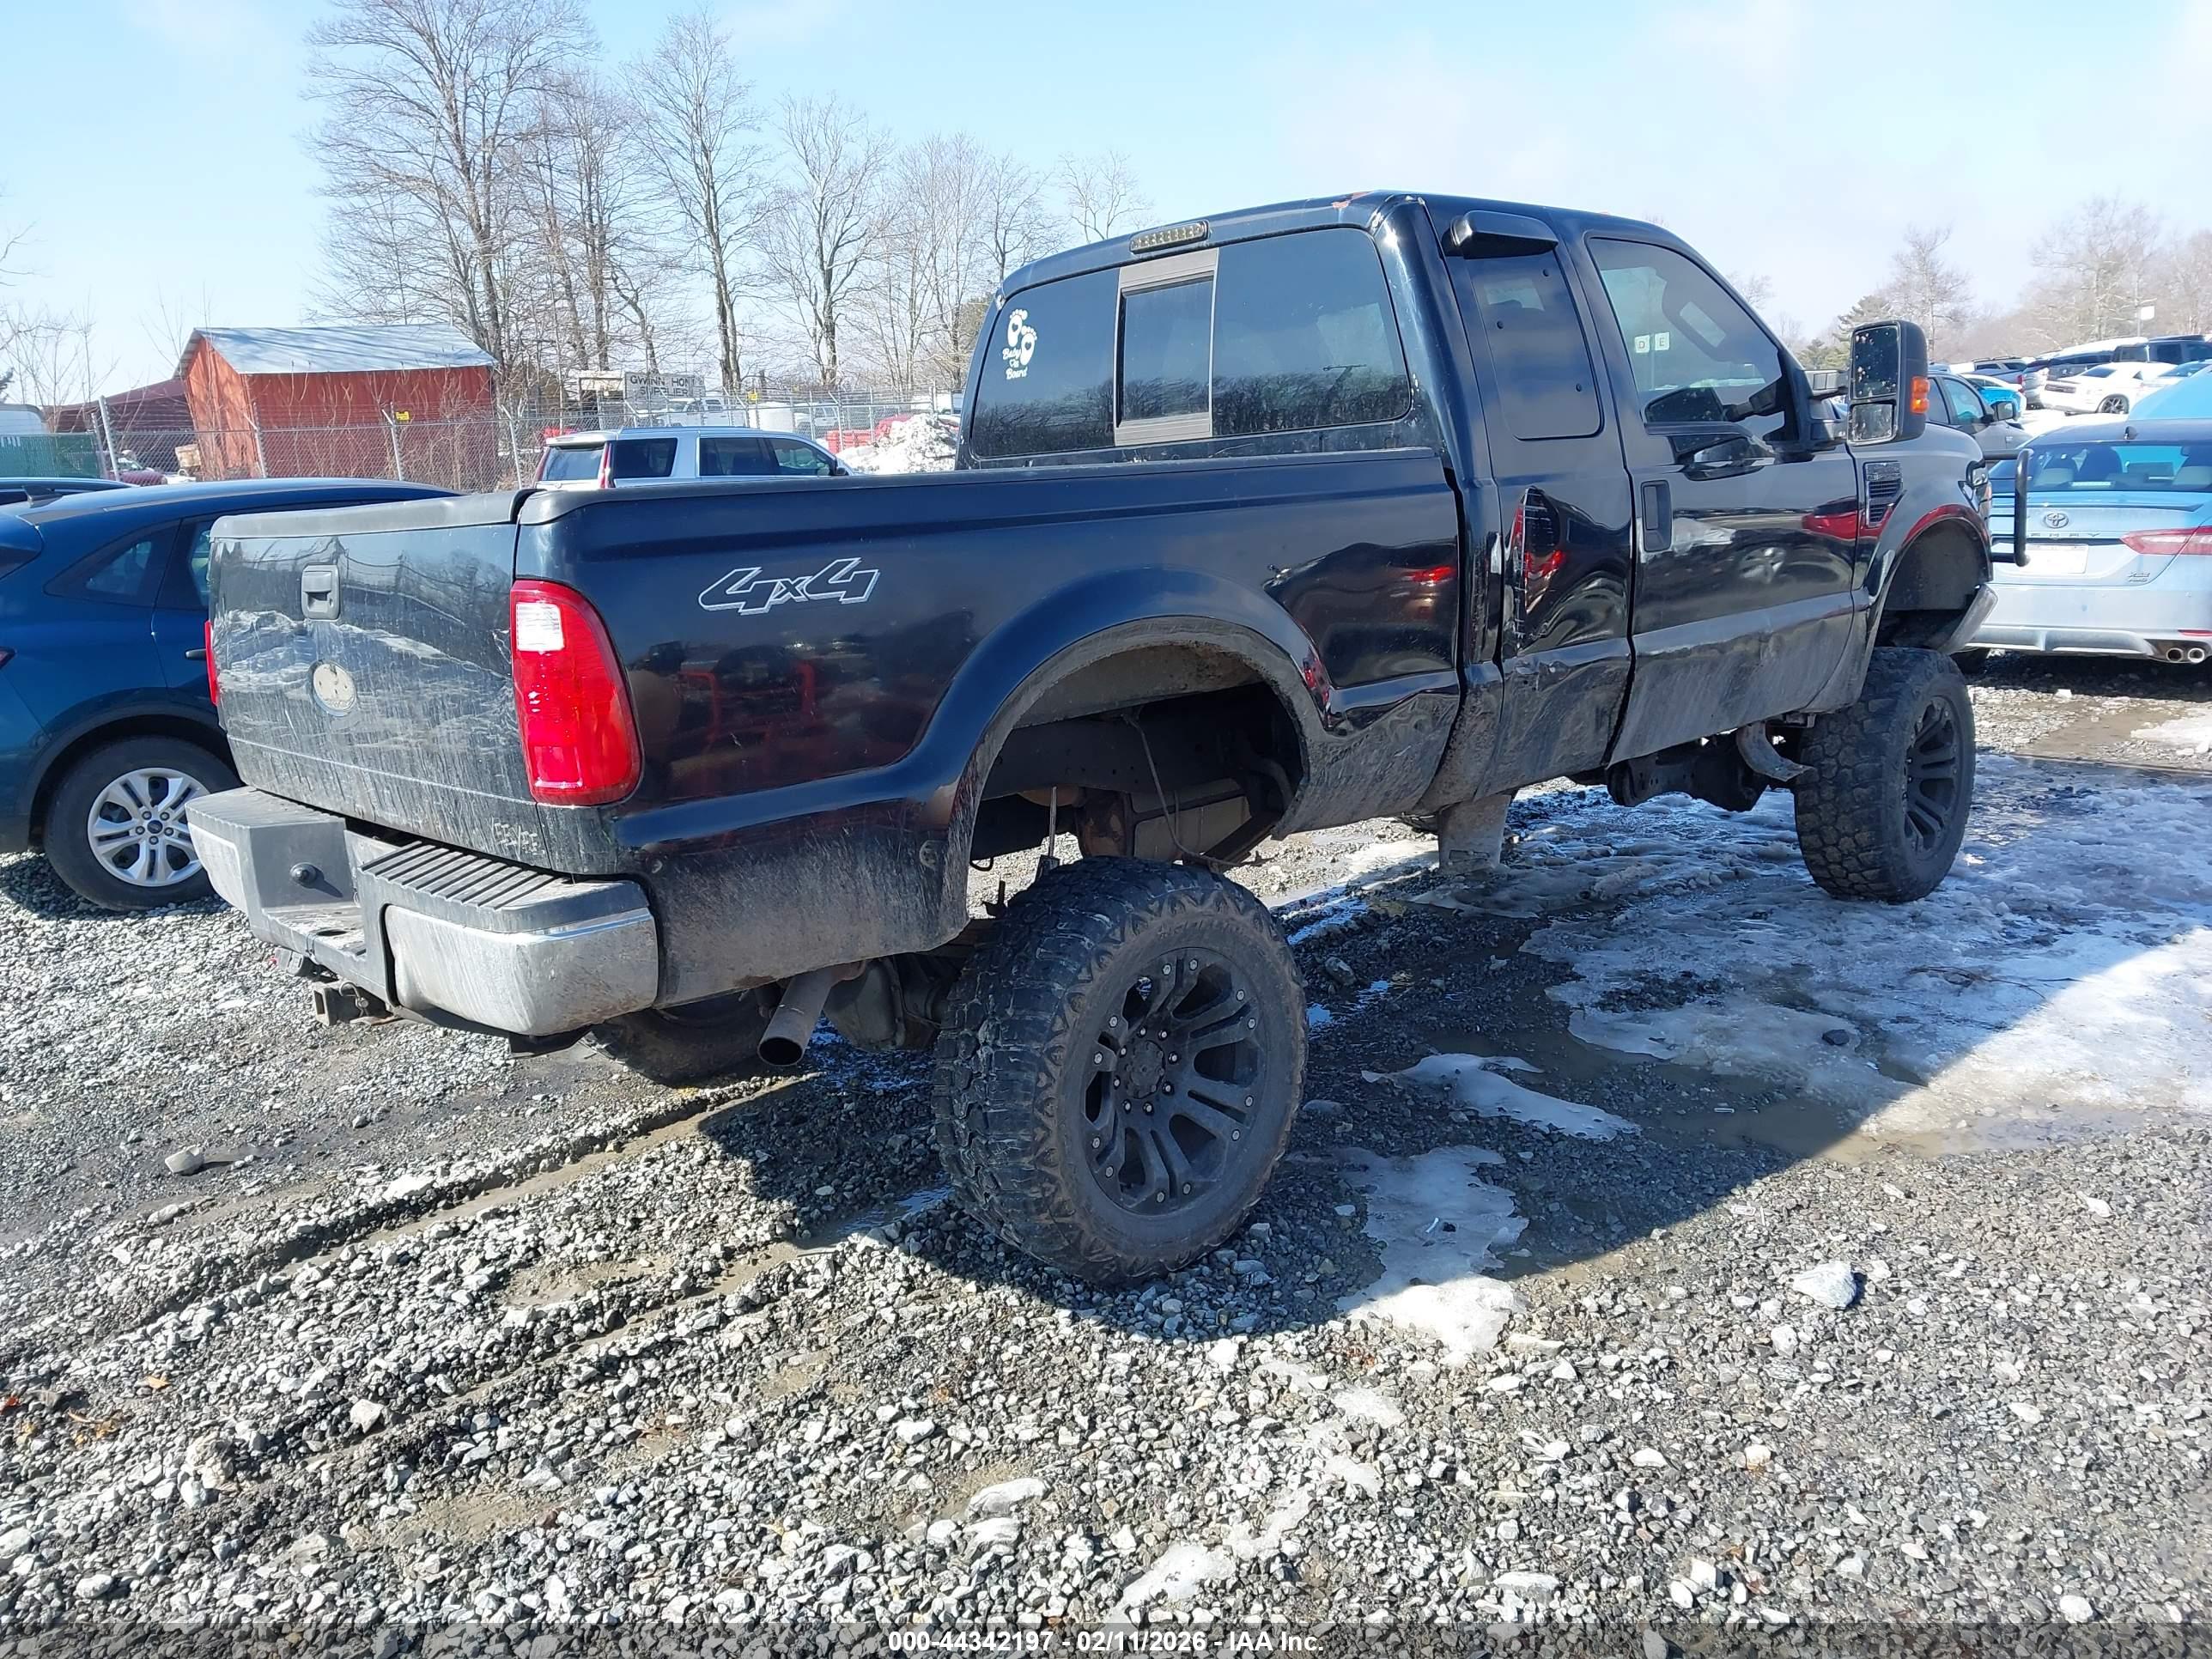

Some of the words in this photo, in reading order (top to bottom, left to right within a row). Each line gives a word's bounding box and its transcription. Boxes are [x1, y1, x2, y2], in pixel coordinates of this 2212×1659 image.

[1002, 347, 1022, 360] Baby
[1006, 366, 1028, 380] Board
[698, 556, 881, 616] 4x4
